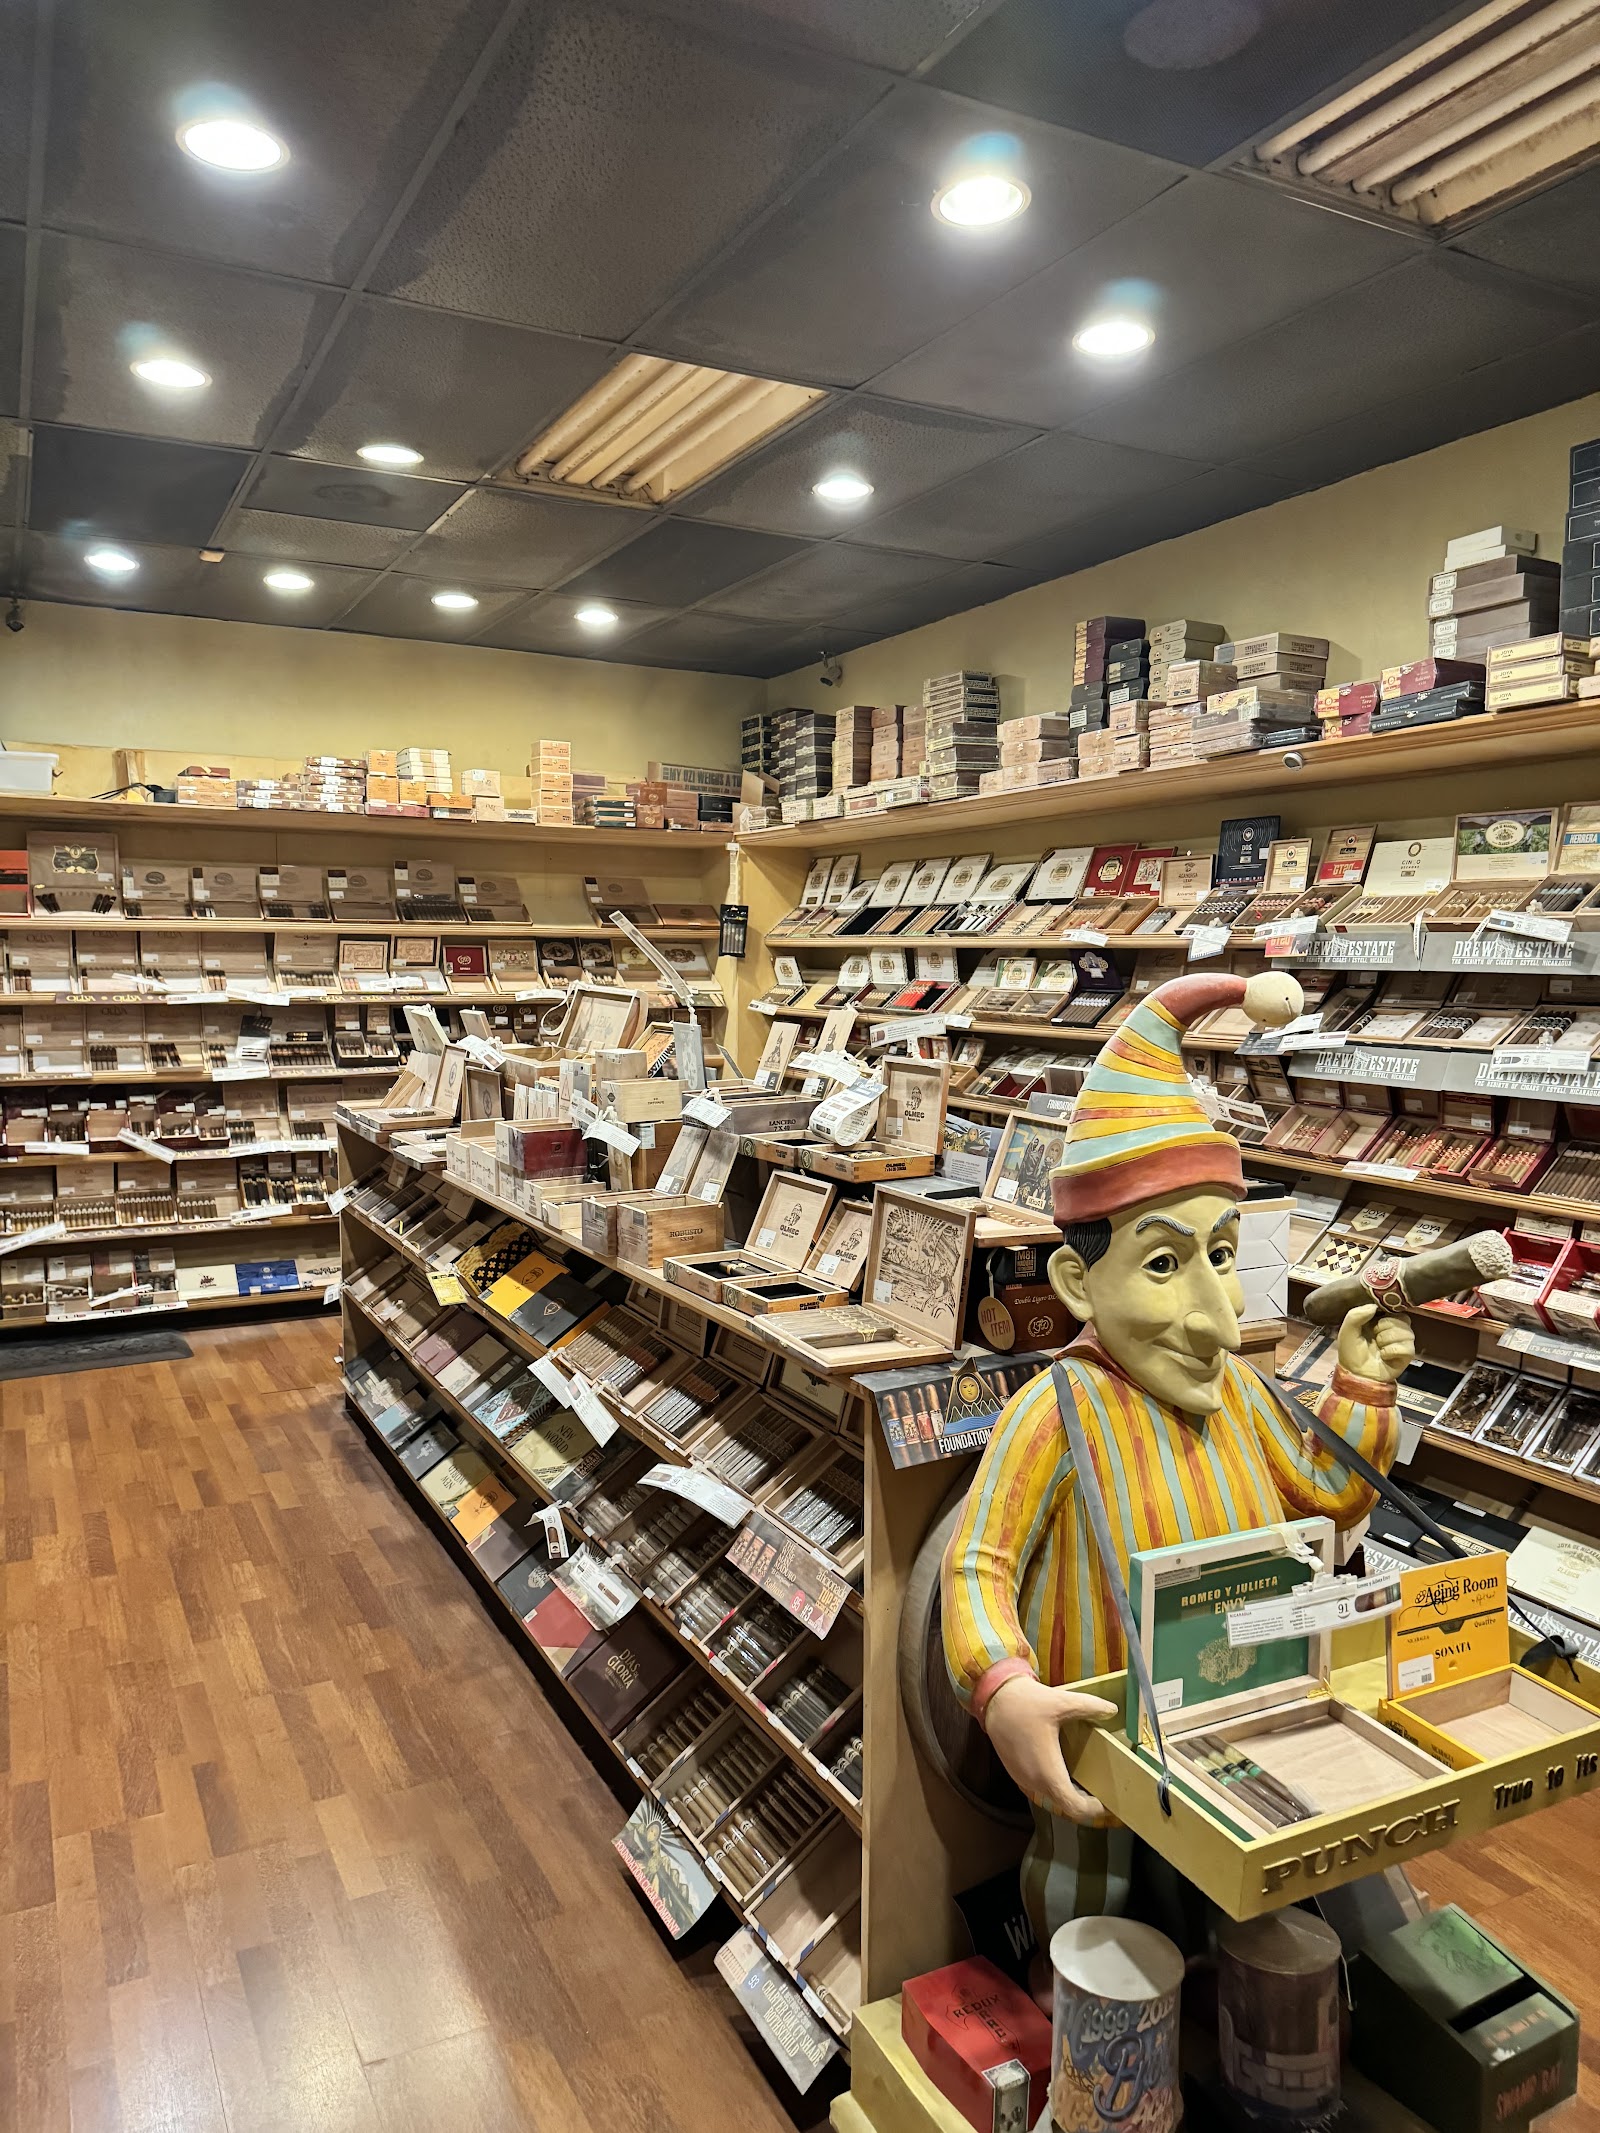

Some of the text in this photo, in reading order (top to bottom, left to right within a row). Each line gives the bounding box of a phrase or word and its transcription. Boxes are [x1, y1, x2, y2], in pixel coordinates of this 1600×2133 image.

[670, 768, 681, 780] MY
[683, 769, 695, 782] UZI
[725, 773, 732, 786] A
[1569, 833, 1598, 843] HERRERA
[1350, 940, 1395, 956] ESTATE
[1453, 941, 1575, 958] DREW ESTATE
[1316, 1052, 1420, 1073] DREW ESTATE
[1521, 1083, 1540, 1091] CIGARS
[769, 1119, 796, 1127] LANCERO
[904, 1110, 925, 1119] OLMEC
[1362, 1208, 1386, 1217] JOYA
[669, 1228, 703, 1238] ROBUSTO
[780, 1224, 799, 1236] OLMEC
[1416, 1222, 1441, 1232] JOYA
[835, 1249, 857, 1261] OLMEC
[1018, 1250, 1034, 1260] M81
[1014, 1295, 1031, 1305] Double
[981, 1307, 996, 1324] HOT
[991, 1320, 1011, 1337] ITEM
[1552, 1347, 1571, 1357] ABOUT
[556, 1421, 577, 1443] NEW
[542, 1426, 570, 1457] WORLD
[440, 1475, 456, 1490] NEW
[449, 1465, 465, 1485] WORLD
[771, 1559, 799, 1582] MADURO
[761, 1576, 788, 1599] Robusto
[1181, 1576, 1279, 1607] ROMEO Y JULIETA
[1463, 1576, 1498, 1594] Room
[789, 1595, 803, 1611] 95
[1214, 1598, 1247, 1615] ENVY
[1338, 1603, 1349, 1614] 91
[798, 1603, 815, 1622] #3
[1474, 1618, 1496, 1628] Quattro
[1434, 1641, 1471, 1659] SONATA
[618, 1648, 640, 1672] DÍAS
[607, 1655, 636, 1690] GLORIA
[1494, 1778, 1534, 1810] True
[1546, 1764, 1564, 1790] to
[1261, 1799, 1462, 1894] PUNCH
[615, 1840, 680, 1936] FOUNDATION CIGAR COMPANY
[745, 1973, 761, 1989] 93
[759, 1978, 791, 2017] CHARTER
[953, 1994, 1001, 2019] REDUX
[780, 2010, 800, 2031] OAK
[1081, 2004, 1130, 2043] 1999
[761, 2006, 801, 2058] ROTHSCHILD
[789, 2024, 807, 2041] CT
[797, 2034, 825, 2067] SHADE
